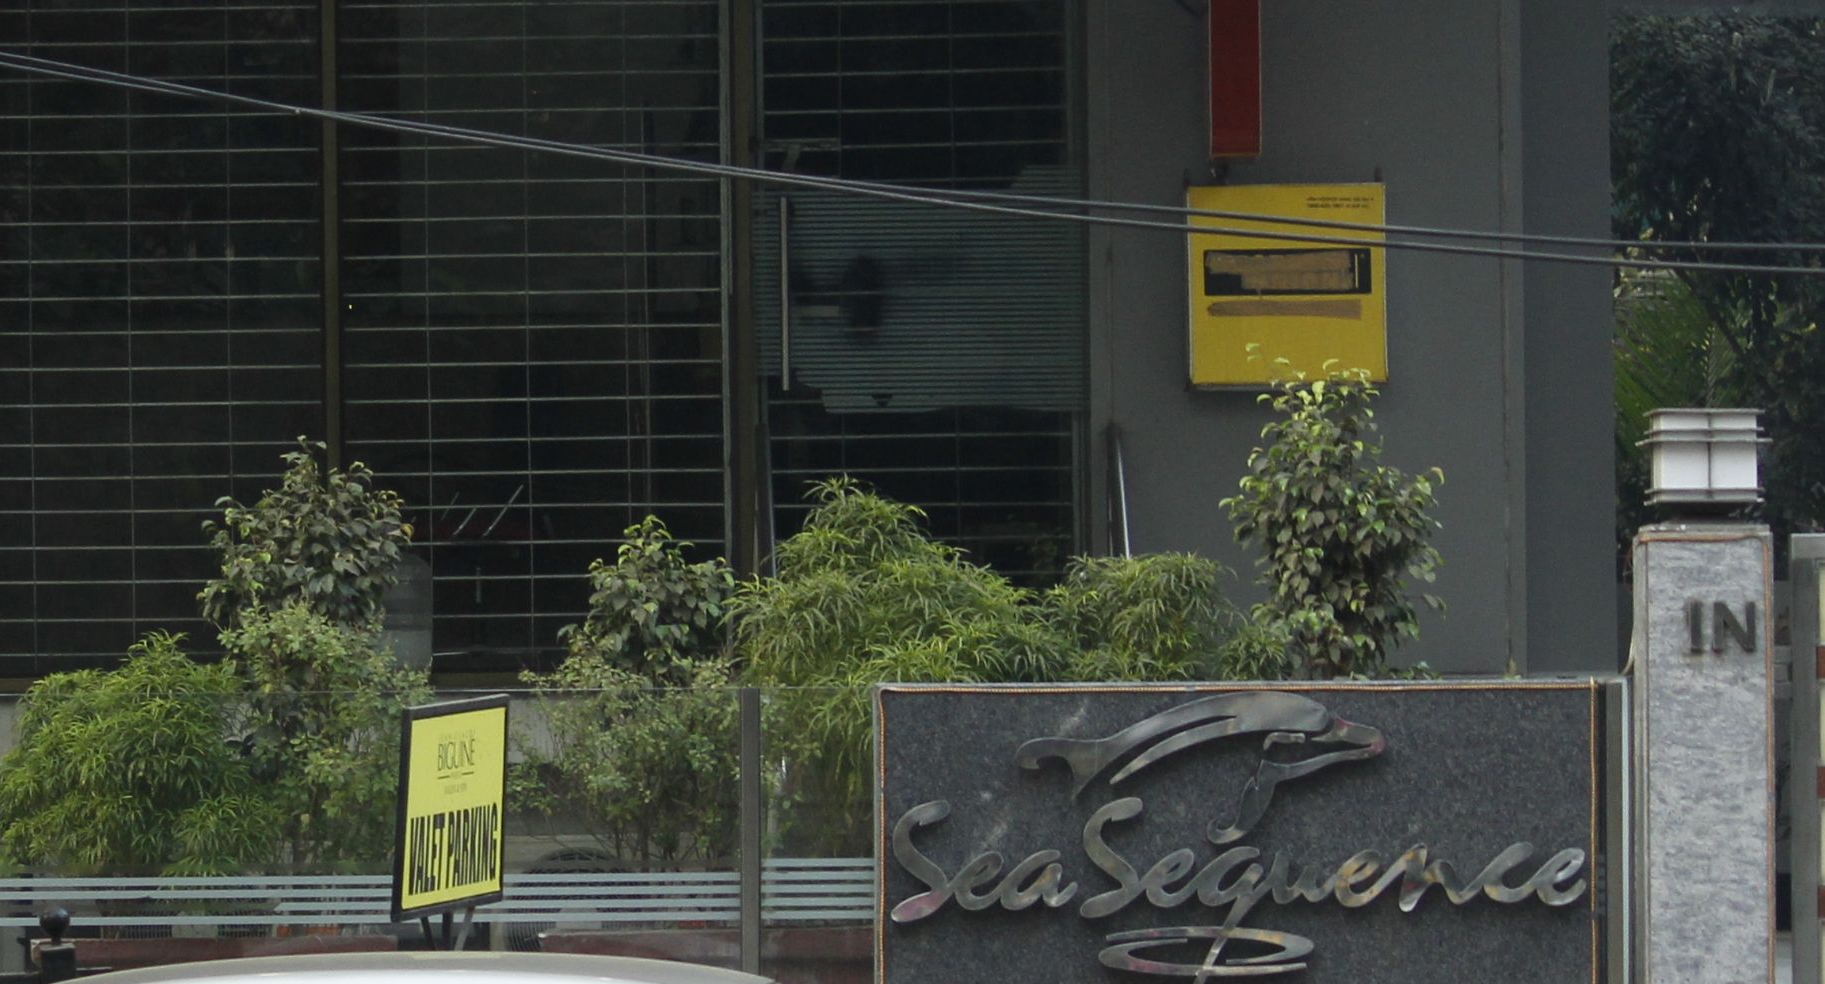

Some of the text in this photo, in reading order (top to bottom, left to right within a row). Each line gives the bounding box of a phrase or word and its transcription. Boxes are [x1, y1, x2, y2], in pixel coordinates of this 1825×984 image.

[1684, 600, 1757, 655] IN
[408, 802, 498, 896] VALET PARKING
[890, 800, 1078, 923] Sea
